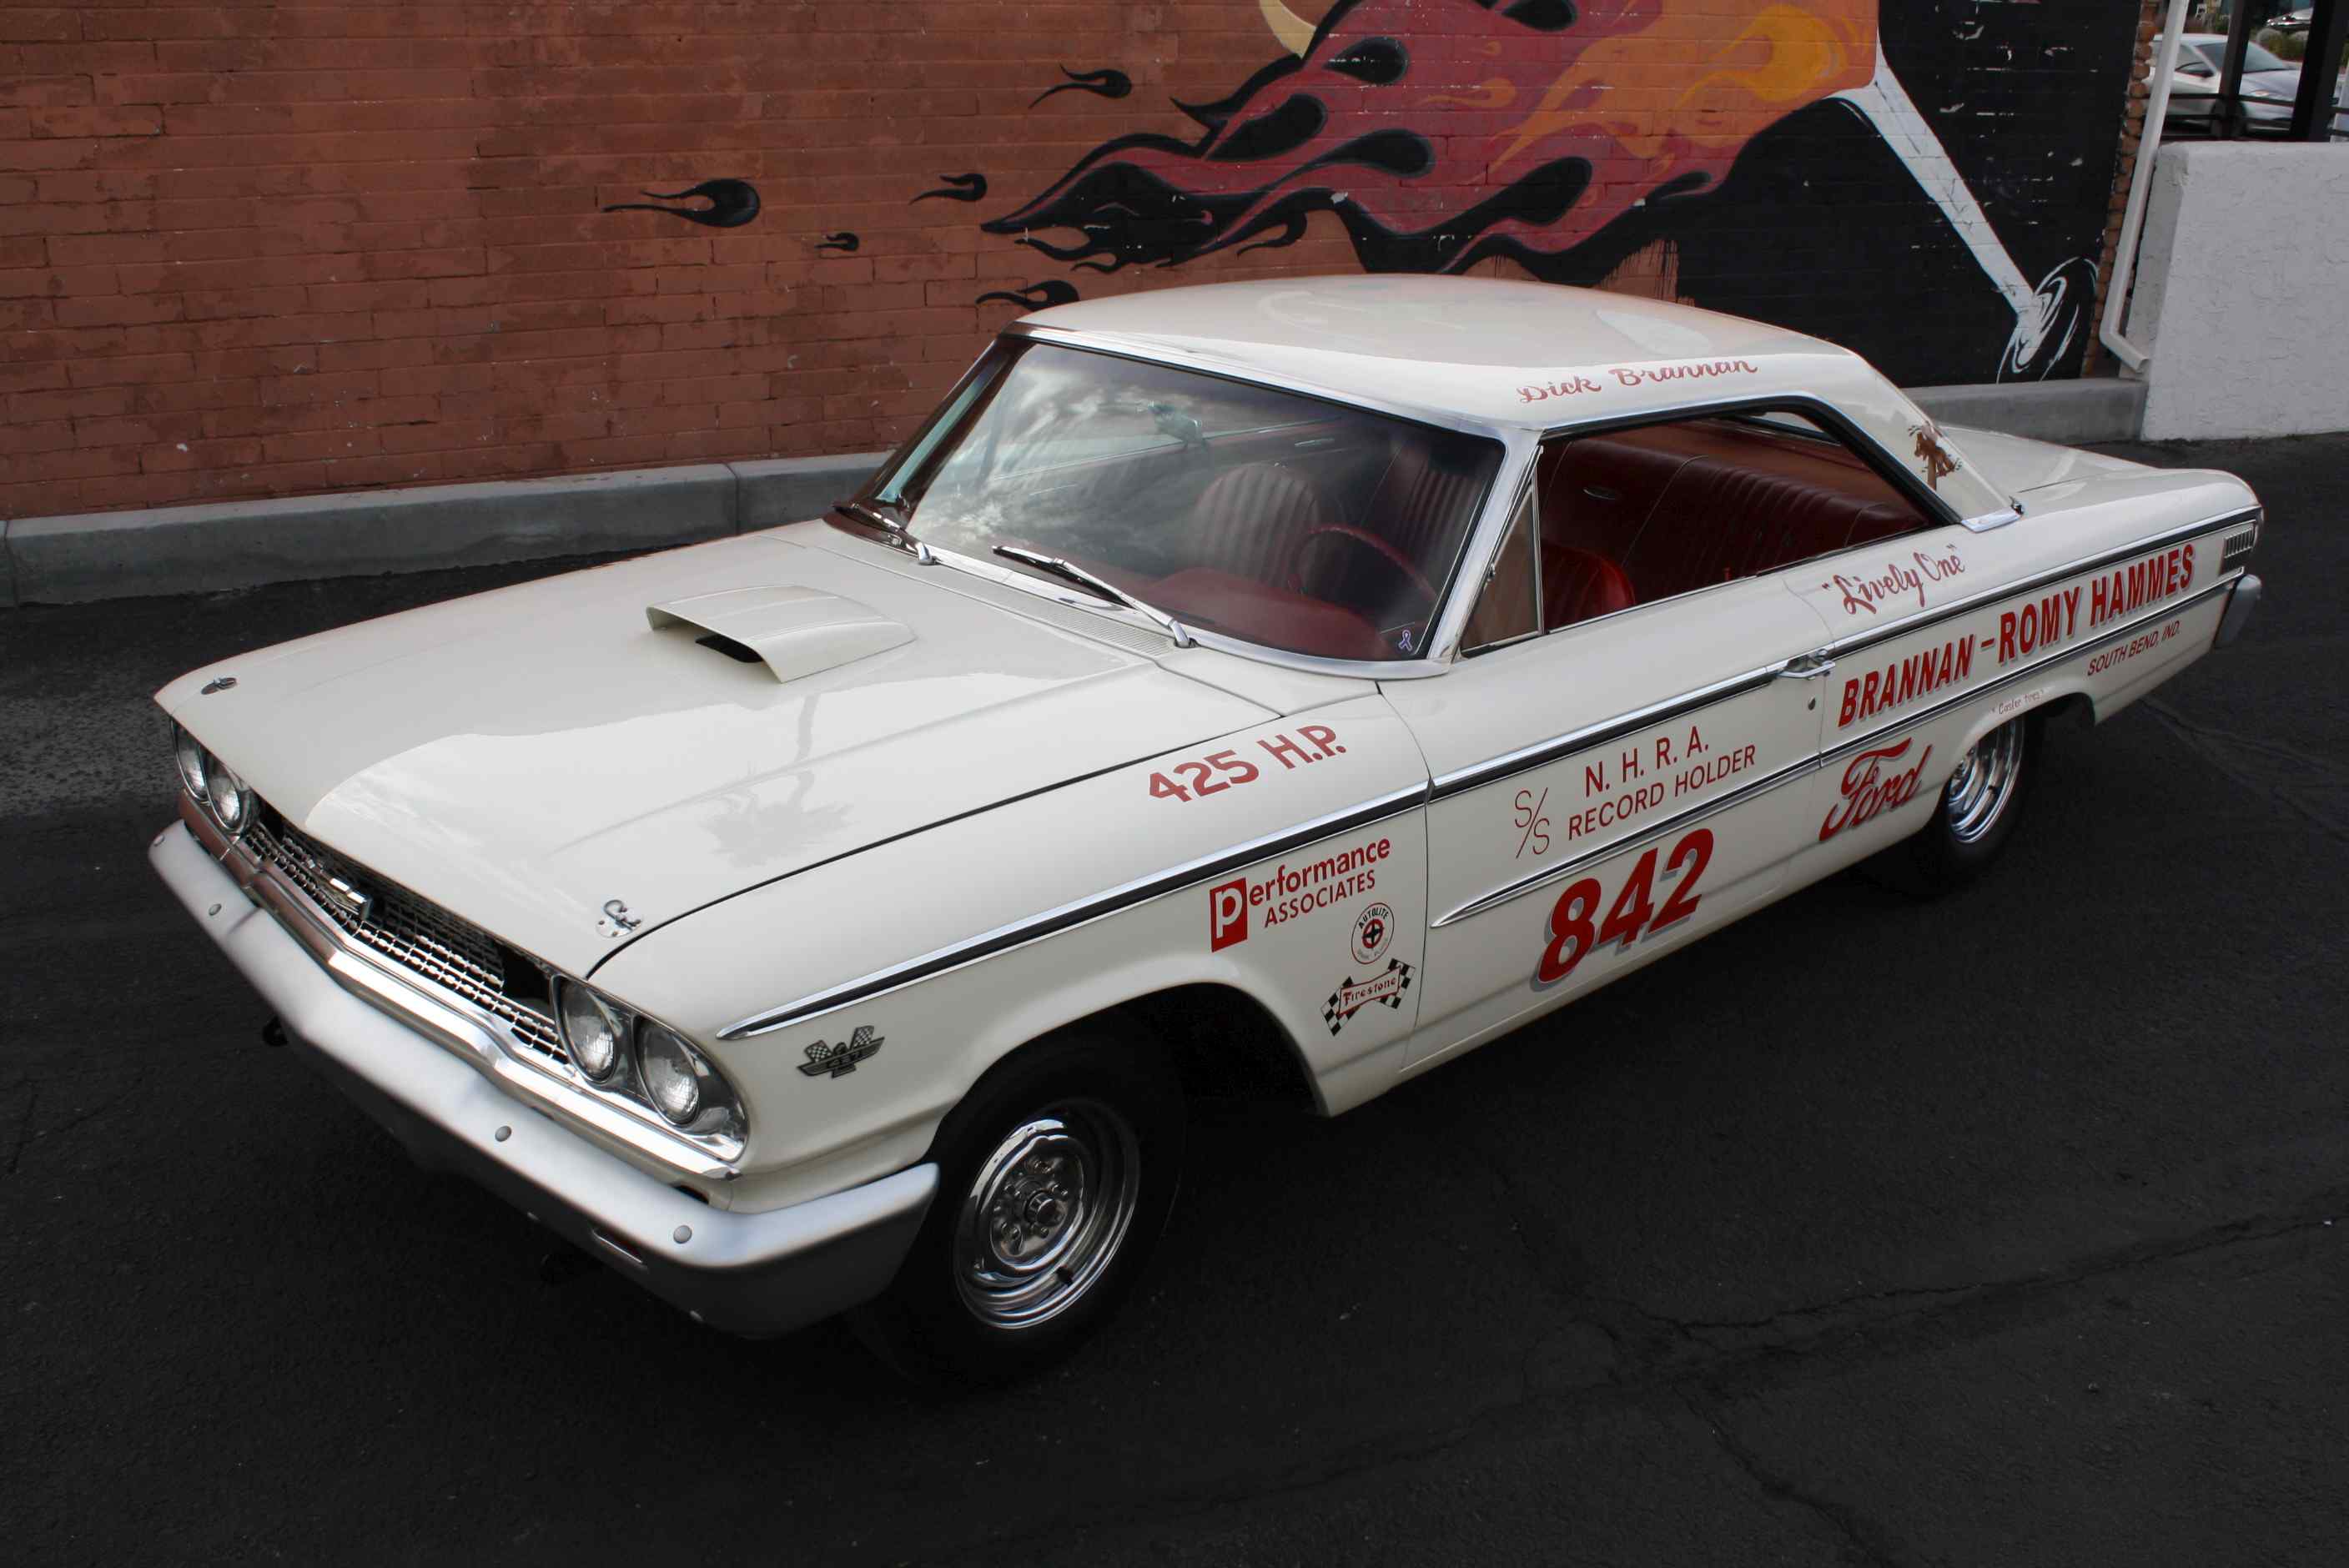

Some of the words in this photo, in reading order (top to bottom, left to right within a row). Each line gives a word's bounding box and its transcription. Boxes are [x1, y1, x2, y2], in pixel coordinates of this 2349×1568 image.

[1517, 376, 1602, 404] Dick
[1608, 359, 1758, 386] Brannan
[1838, 634, 1976, 729] BRANNAN
[1998, 585, 2083, 665] ROMY
[2089, 544, 2195, 629] HAMMES
[2087, 644, 2128, 676] SOUTH
[1149, 749, 1260, 802] 425
[1255, 725, 1347, 769] H.P.
[1568, 781, 1664, 841] RECORD
[1675, 744, 1756, 797] HOLDER
[1818, 736, 1934, 842] Ford
[1264, 869, 1376, 928] ASSOCIATES
[1358, 907, 1389, 929] AUTOLITE
[1533, 827, 1714, 984] 842
[1342, 977, 1397, 1007] Firestone
